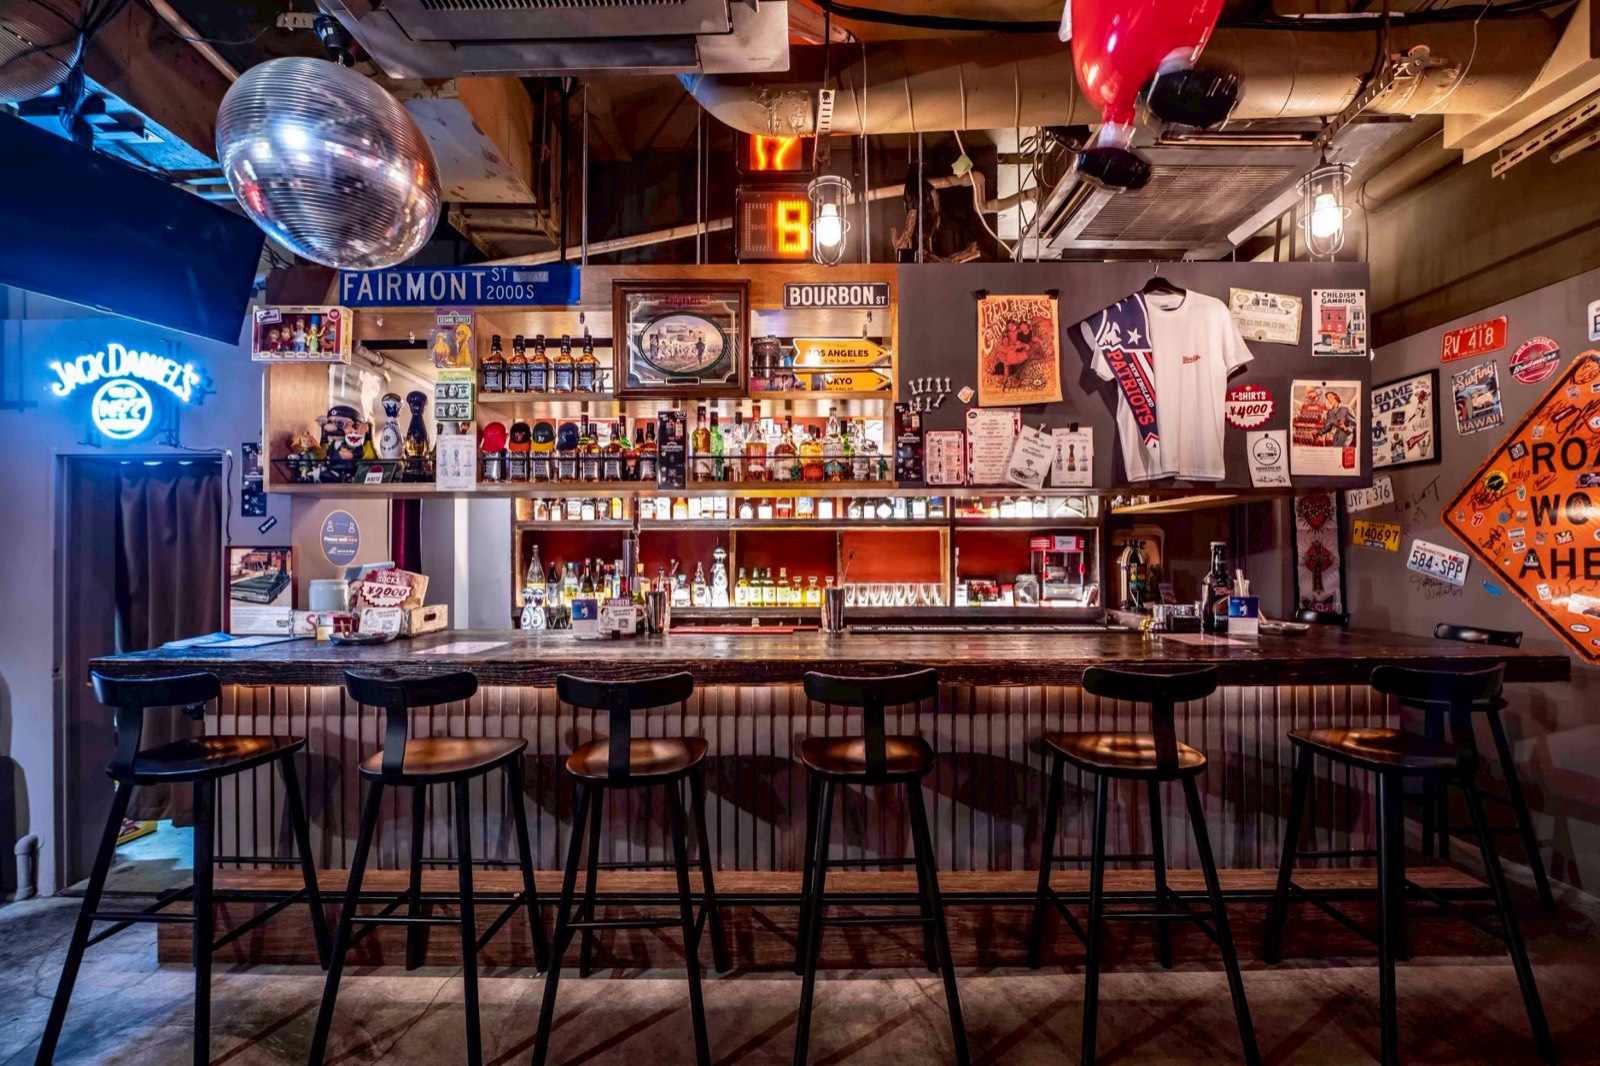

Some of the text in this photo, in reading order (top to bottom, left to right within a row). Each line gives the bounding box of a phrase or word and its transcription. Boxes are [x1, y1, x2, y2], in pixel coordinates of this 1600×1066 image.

[344, 272, 485, 300] FAIRMONT
[492, 268, 508, 281] ST
[790, 286, 886, 305] BOURBON ST
[1321, 291, 1356, 299] CHILDISH
[50, 351, 107, 396] JACK
[1455, 364, 1494, 391] Surfing
[1107, 350, 1155, 425] PATRIOTS
[1129, 362, 1155, 407] NEW ENGLAND
[1374, 382, 1413, 405] GAME
[1231, 391, 1266, 401] T-SHIRTS
[1379, 393, 1413, 414] DAY
[1230, 403, 1268, 419] ¥4000
[1460, 414, 1500, 432] HAWAII
[1532, 437, 1600, 474] RO
[1372, 484, 1390, 501] 376
[366, 586, 407, 598] ¥2000
